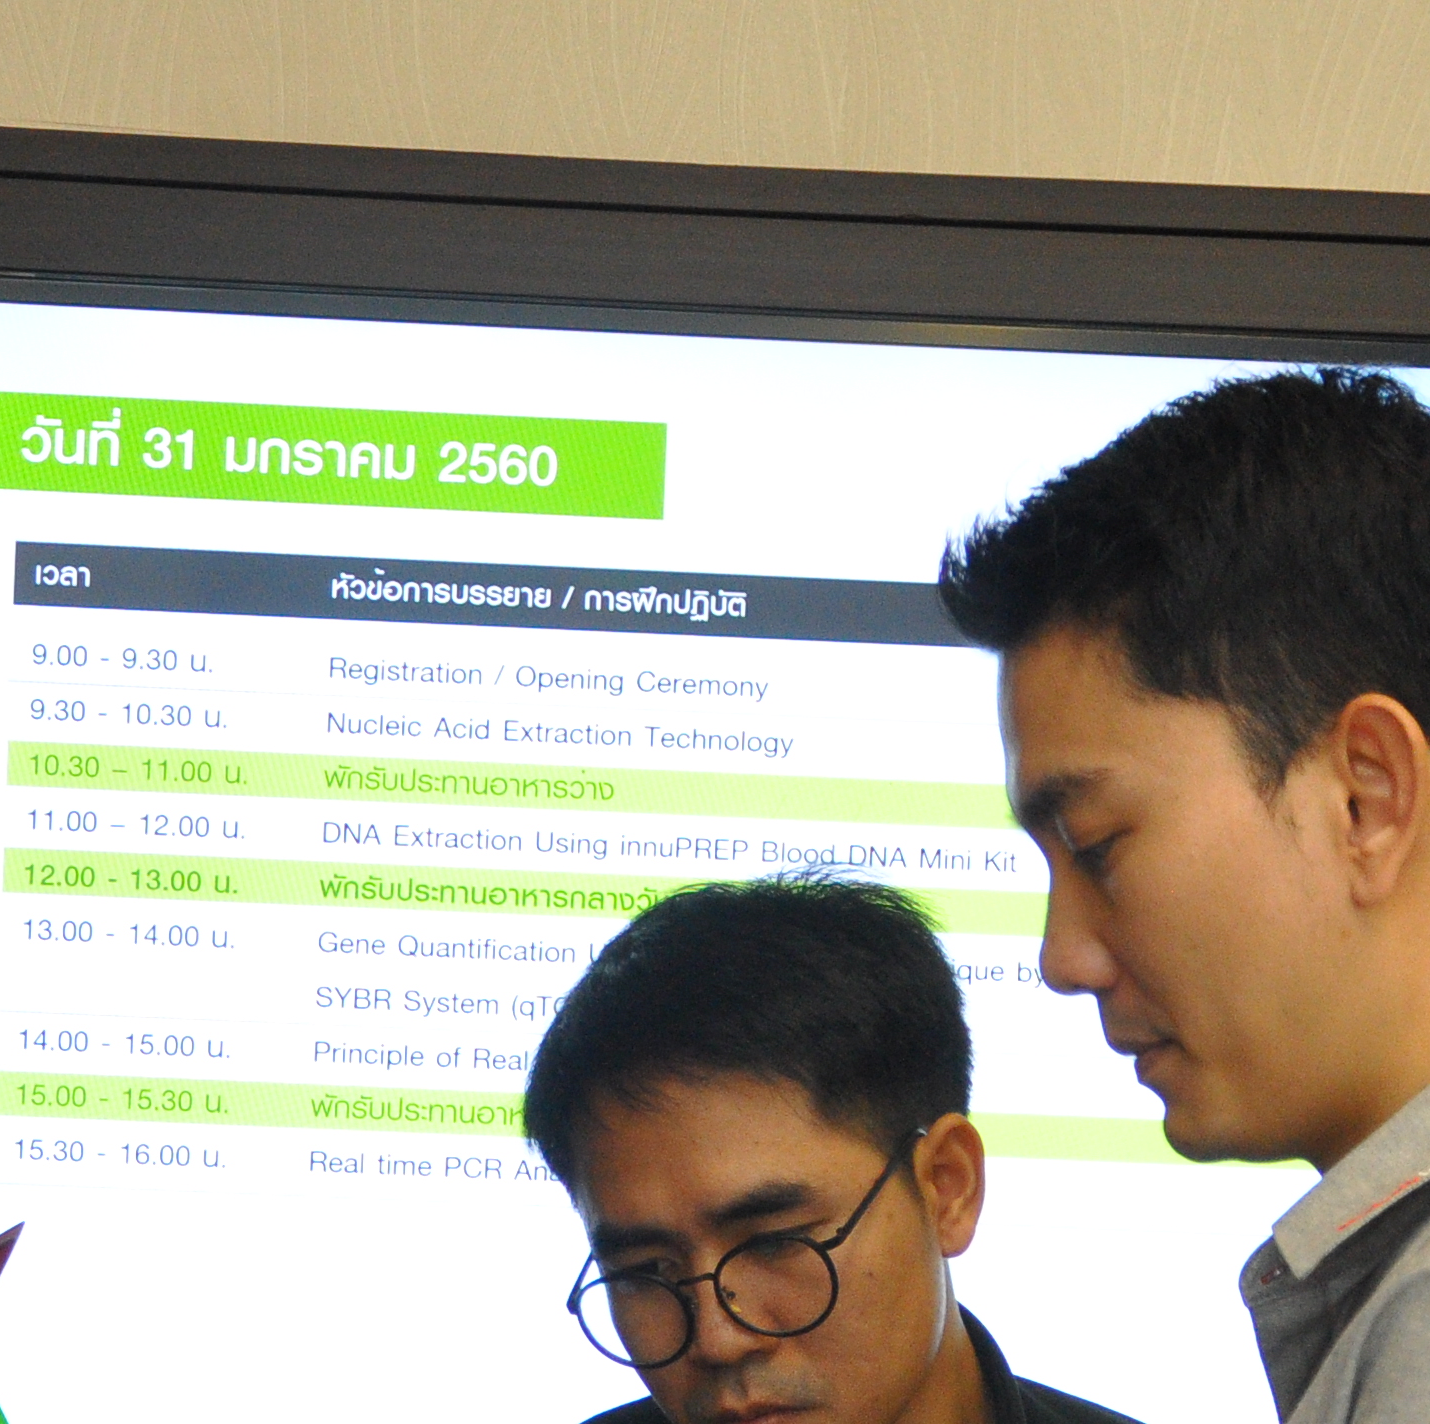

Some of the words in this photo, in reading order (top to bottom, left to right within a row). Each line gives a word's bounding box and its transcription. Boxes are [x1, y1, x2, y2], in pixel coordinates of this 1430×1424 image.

[21, 407, 121, 467] วันที่
[142, 427, 194, 470] 31
[226, 431, 416, 481] มกราคม
[438, 440, 559, 487] 2560
[34, 565, 90, 587] เวลา
[330, 568, 551, 608] หัวข้อการบรรยาย
[561, 586, 575, 610] /
[584, 585, 747, 622] การฝึกปฏิบัติ
[33, 643, 87, 667] 9.00
[123, 648, 177, 671] 9.30
[191, 655, 213, 673] น.
[330, 657, 482, 685] Registration
[495, 666, 504, 684] /
[516, 666, 623, 696] Opening
[637, 671, 768, 701] Ceremony
[31, 699, 85, 721] 9.30
[124, 703, 191, 726] 10.30
[205, 710, 227, 729] น.
[328, 712, 421, 736] Nucleic
[434, 717, 489, 739] Acid
[504, 720, 631, 745] Extraction
[646, 726, 793, 758] Technology
[32, 755, 99, 777] 10.30
[143, 759, 211, 782] 11.00
[226, 766, 248, 785] น.
[325, 766, 615, 801] พักรับประทานอาหารว่าง
[29, 810, 97, 832] 11.00
[141, 814, 209, 837] 12.00
[223, 821, 245, 839] น.
[323, 822, 381, 845] DNA
[395, 825, 521, 850] Extraction
[536, 832, 607, 860] Using
[621, 836, 748, 860] innuPREP
[762, 841, 836, 866] Blood
[848, 844, 907, 868] DNA
[920, 848, 970, 869] Mini
[985, 852, 1015, 872] Kit
[26, 864, 95, 887] 12.00
[132, 869, 201, 892] 13.00
[215, 876, 238, 894] น.
[24, 919, 93, 942] 13.00
[131, 924, 199, 947] 14.00
[212, 931, 234, 949] น.
[319, 932, 385, 954] Gene
[398, 935, 576, 963] Quantification
[317, 987, 391, 1009] SYBR
[405, 991, 498, 1017] System
[20, 1029, 88, 1052] 14.00
[127, 1034, 195, 1056] 15.00
[208, 1040, 230, 1059] น.
[315, 1041, 424, 1070] Principle
[437, 1047, 460, 1067] of
[474, 1048, 529, 1071] Real
[19, 1085, 86, 1107] 15.00
[126, 1089, 192, 1111] 15.30
[206, 1095, 228, 1113] น.
[16, 1139, 84, 1162] 15.30
[122, 1144, 190, 1166] 16.00
[204, 1150, 225, 1168] น.
[310, 1151, 363, 1173] Real
[379, 1156, 431, 1176] time
[445, 1157, 501, 1178] PCR
